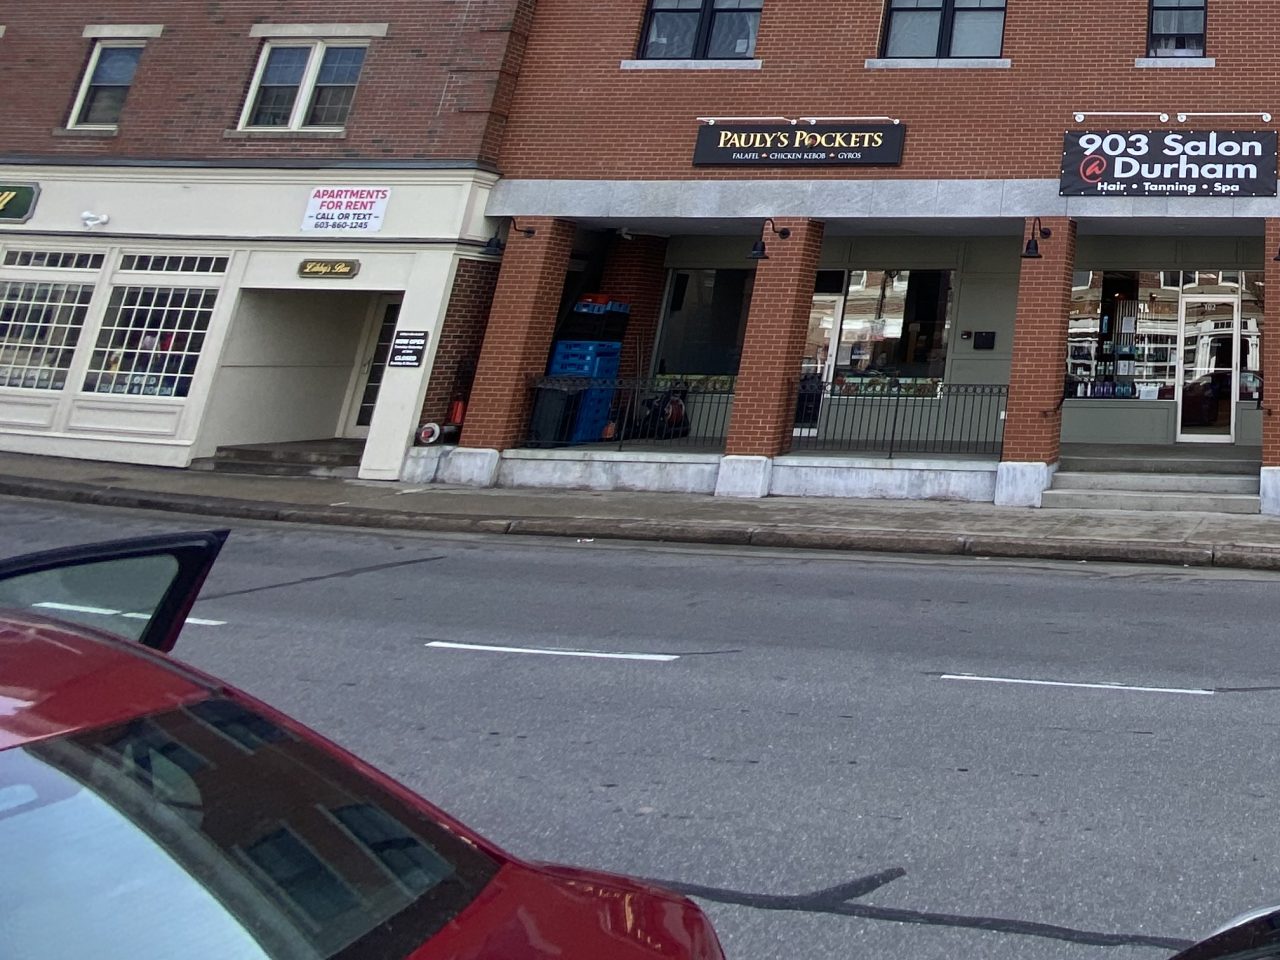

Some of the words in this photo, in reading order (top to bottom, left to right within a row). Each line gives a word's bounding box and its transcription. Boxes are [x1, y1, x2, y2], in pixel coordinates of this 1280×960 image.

[717, 130, 789, 148] PAULY'S
[793, 130, 883, 149] POCKETS
[1078, 133, 1149, 156] 903
[1162, 132, 1262, 156] Salon
[732, 152, 760, 160] FALAFEL
[769, 152, 802, 160] CHICKEN
[803, 152, 826, 160] KEBOB
[837, 152, 862, 160] GYROS
[1113, 155, 1257, 179] Durham
[1097, 182, 1126, 191] Hair
[1143, 182, 1196, 193] Tanning
[1214, 182, 1240, 194] Spa
[313, 189, 389, 199] APARTMENTS
[319, 200, 343, 210] FOR
[345, 201, 376, 210] RENT
[315, 212, 335, 220] CALL
[337, 212, 350, 220] OR
[314, 221, 369, 229] 603-860-1245
